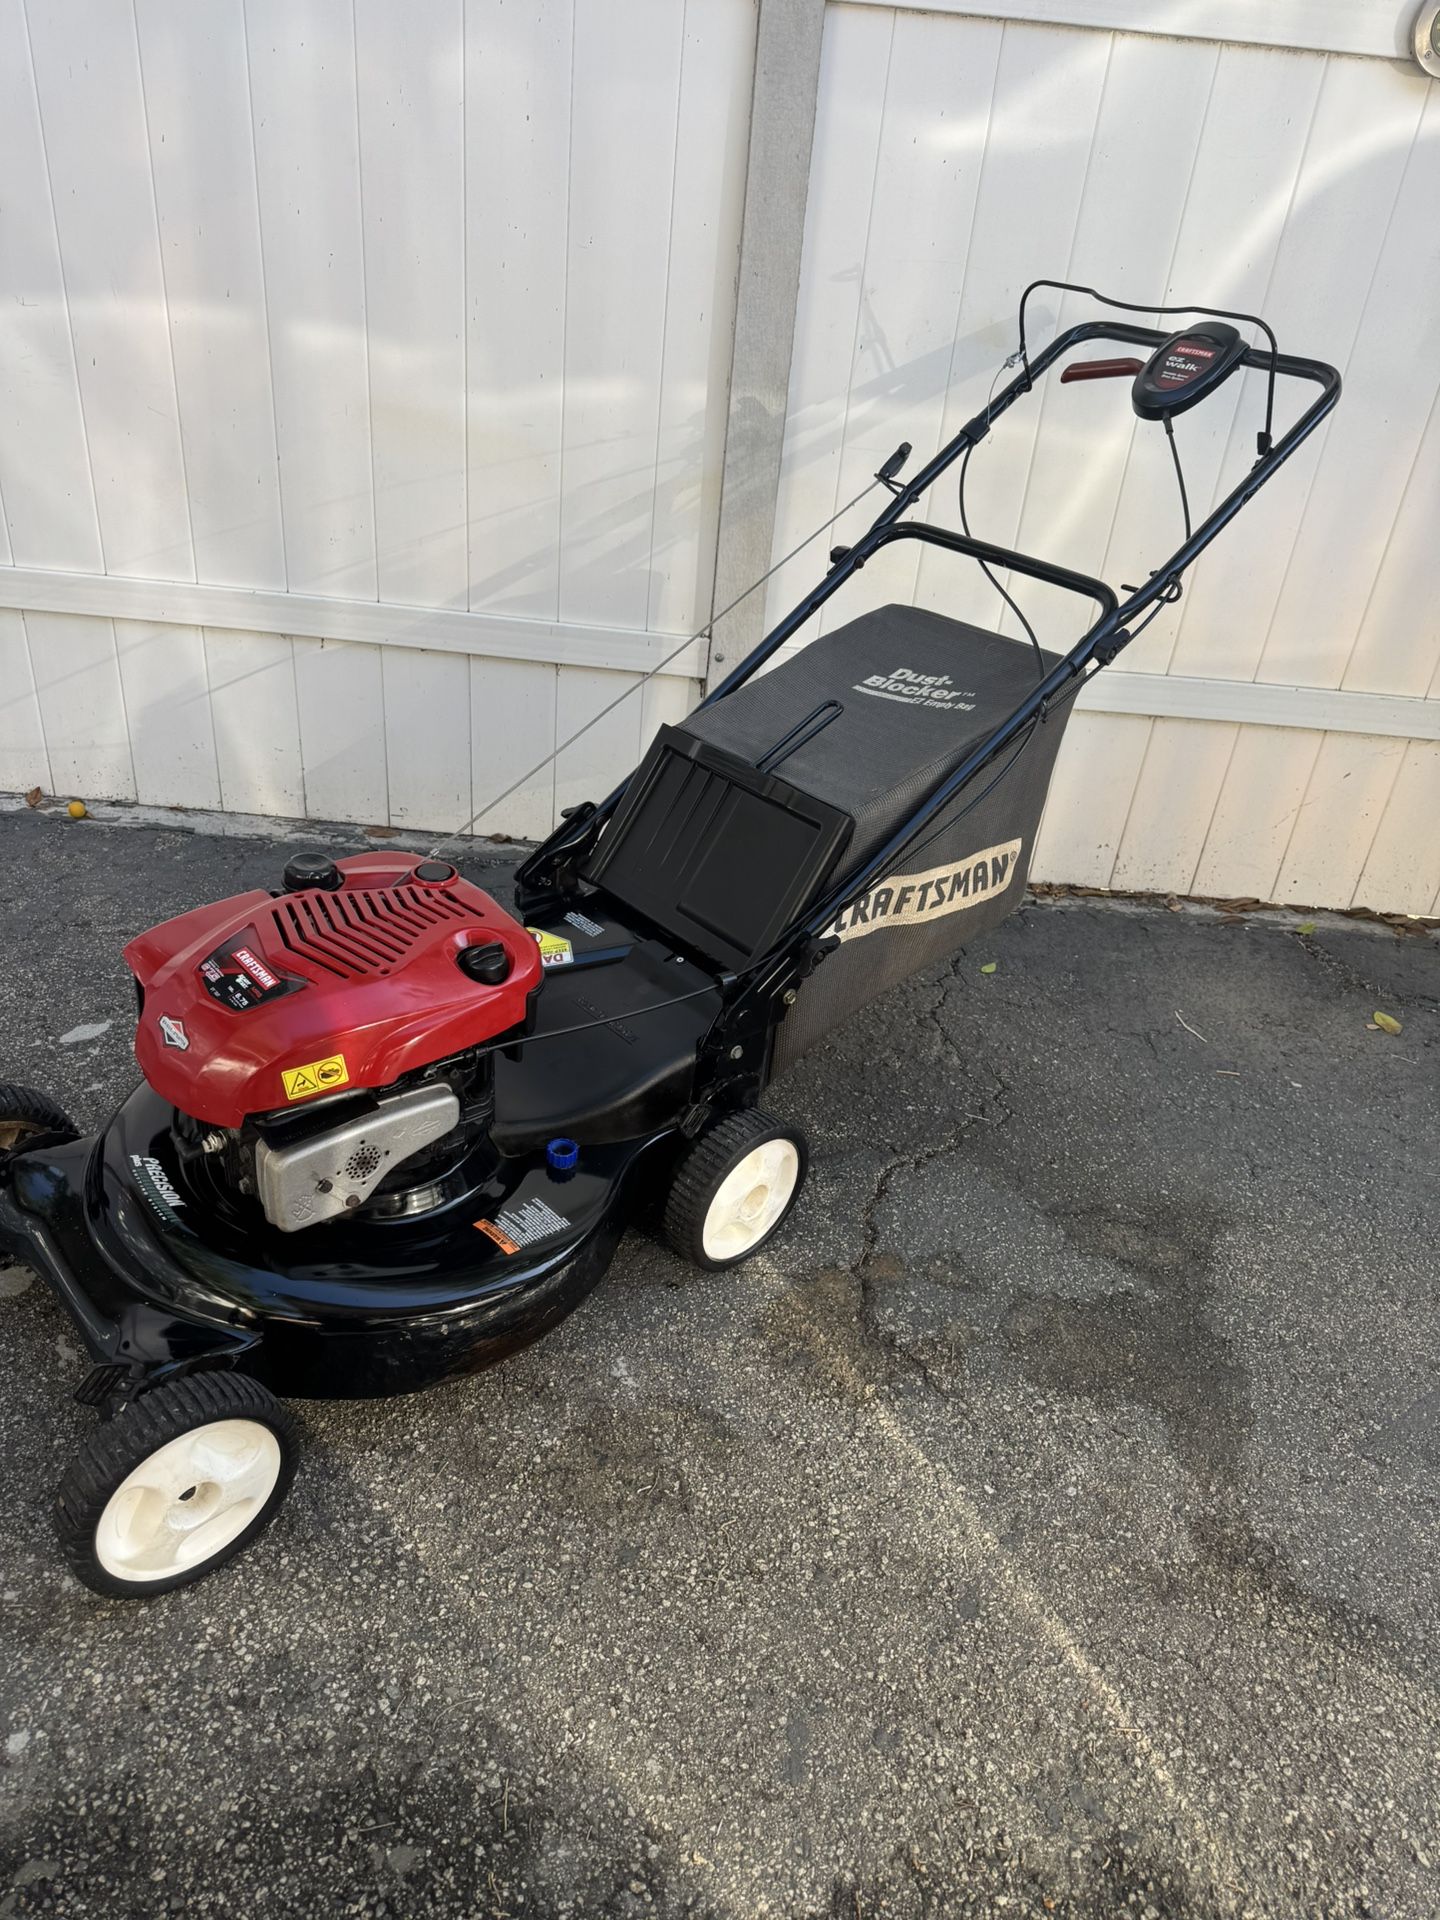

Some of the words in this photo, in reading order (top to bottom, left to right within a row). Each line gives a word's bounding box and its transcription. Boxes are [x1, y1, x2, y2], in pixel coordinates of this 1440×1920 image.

[1174, 346, 1215, 358] CRAFTSMAN
[1167, 355, 1186, 363] ez
[888, 668, 954, 686] Dust-
[923, 699, 954, 709] Empty
[954, 702, 977, 711] Bag
[236, 950, 276, 988] CRAFTSMAN
[129, 1154, 143, 1167] plus
[142, 1157, 186, 1207] PRECISION
